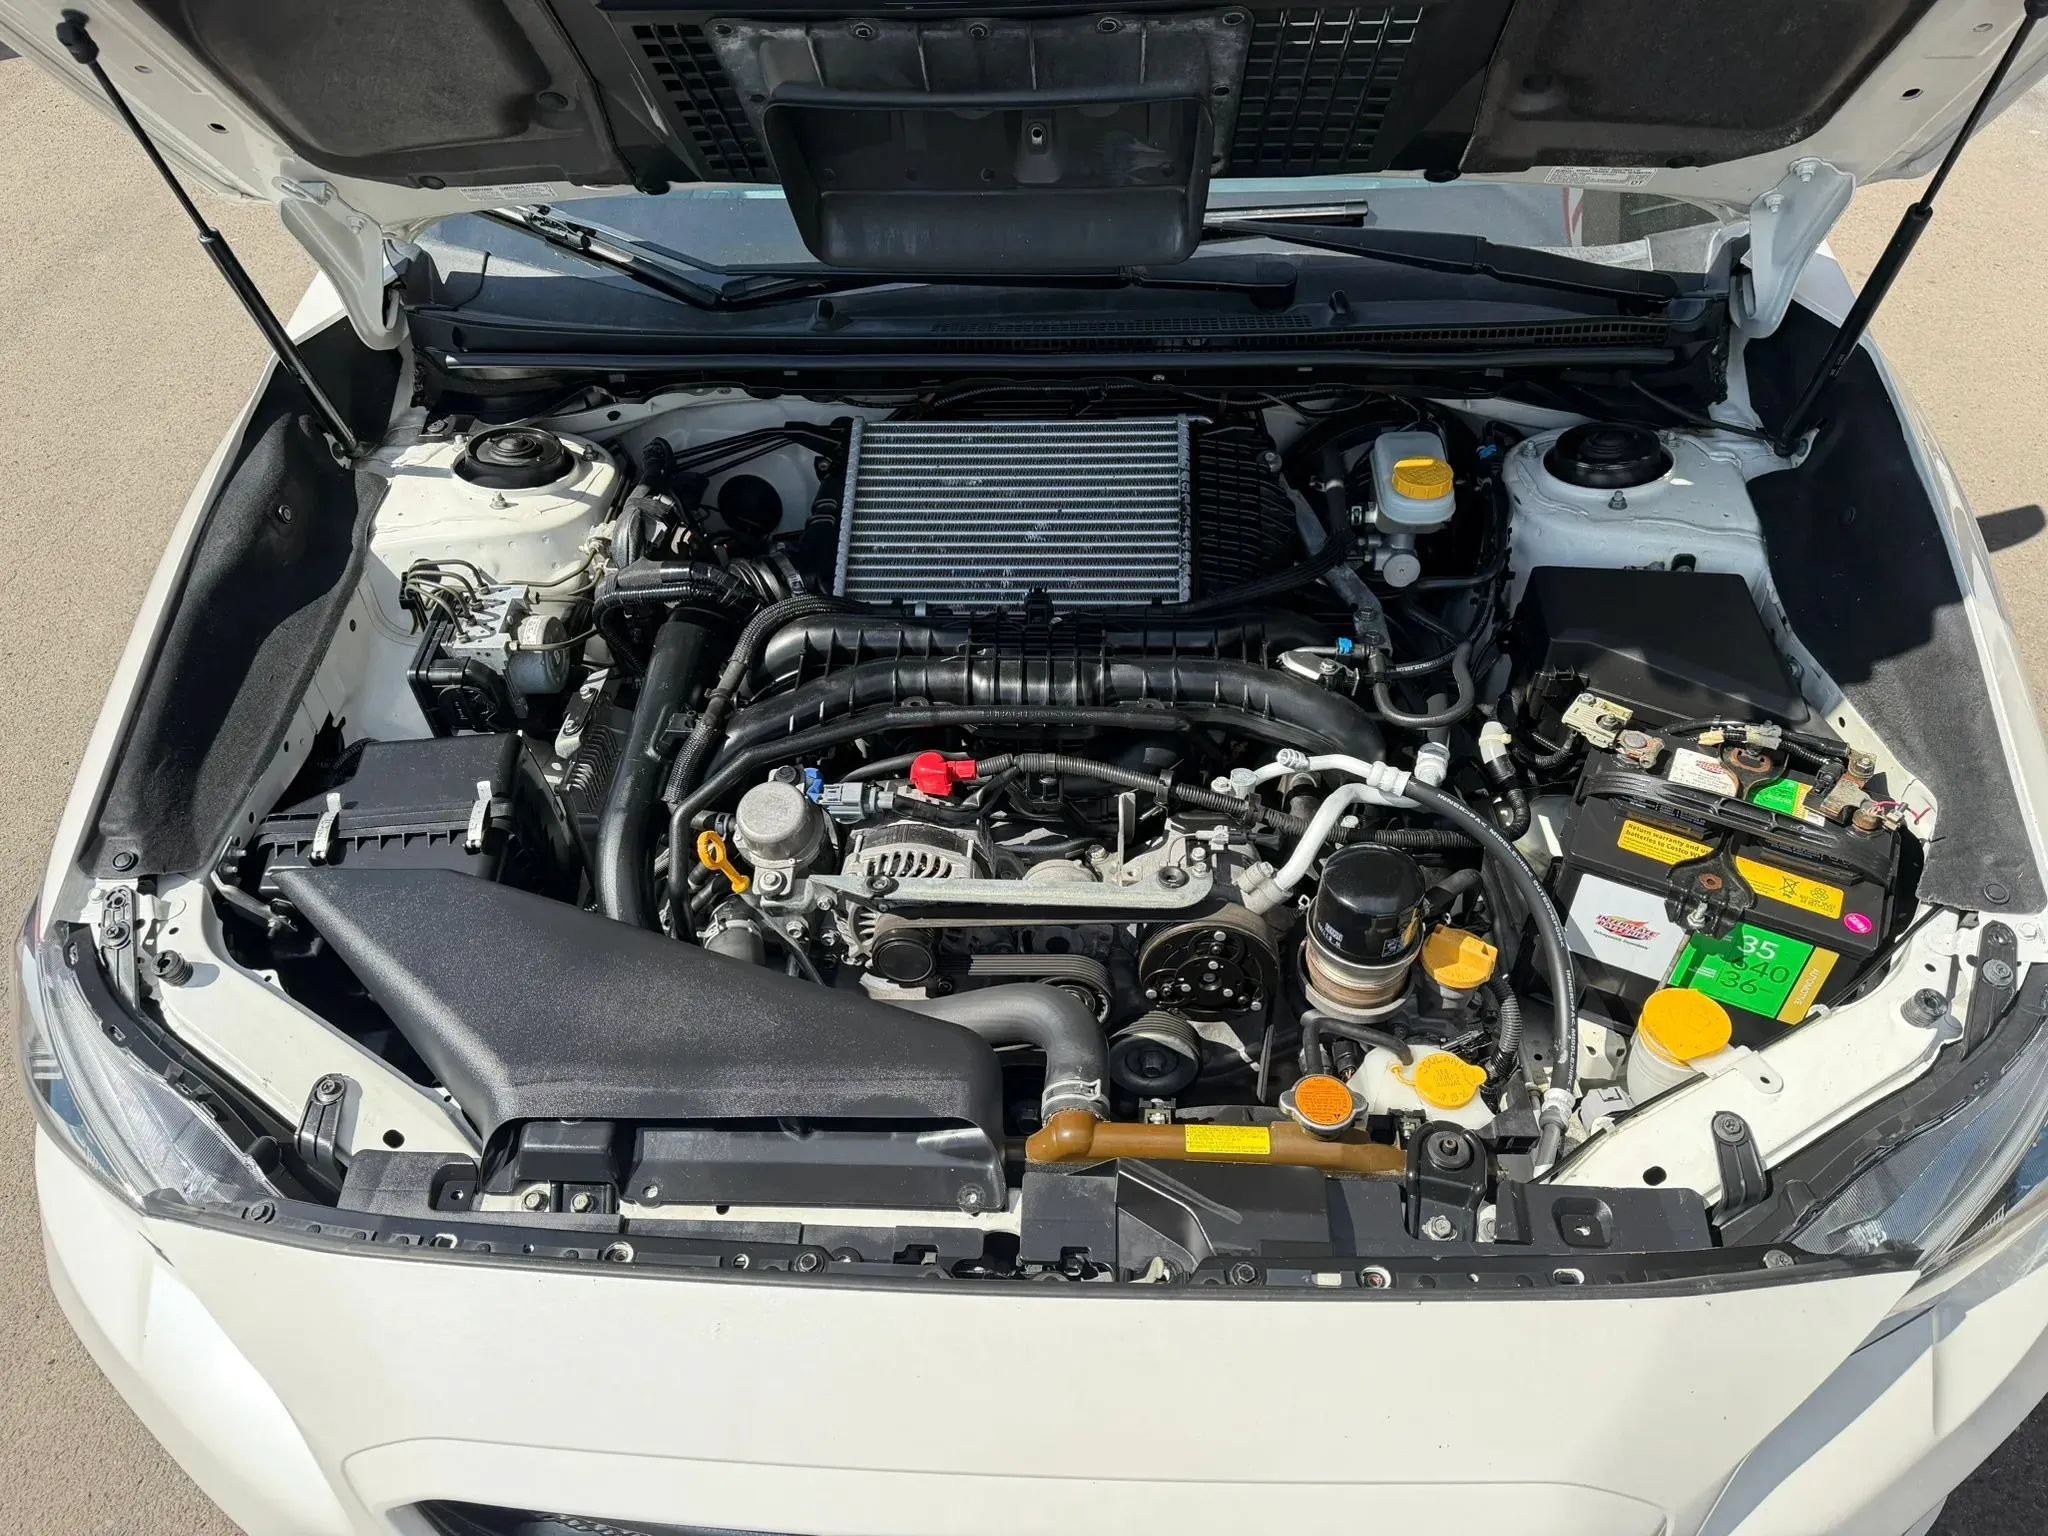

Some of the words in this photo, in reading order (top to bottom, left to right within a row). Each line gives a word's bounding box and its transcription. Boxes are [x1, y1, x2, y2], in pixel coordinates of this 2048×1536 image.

[1625, 829, 1657, 845] batteries
[1657, 840, 1665, 848] to
[1666, 843, 1689, 856] Costco
[1627, 823, 1652, 835] Return
[1653, 832, 1685, 847] warranty
[1686, 843, 1700, 852] and
[1596, 914, 1658, 936] INTERSTATE
[1596, 920, 1650, 940] BATTERIES
[1737, 935, 1780, 960] 35
[1730, 956, 1790, 984] 640
